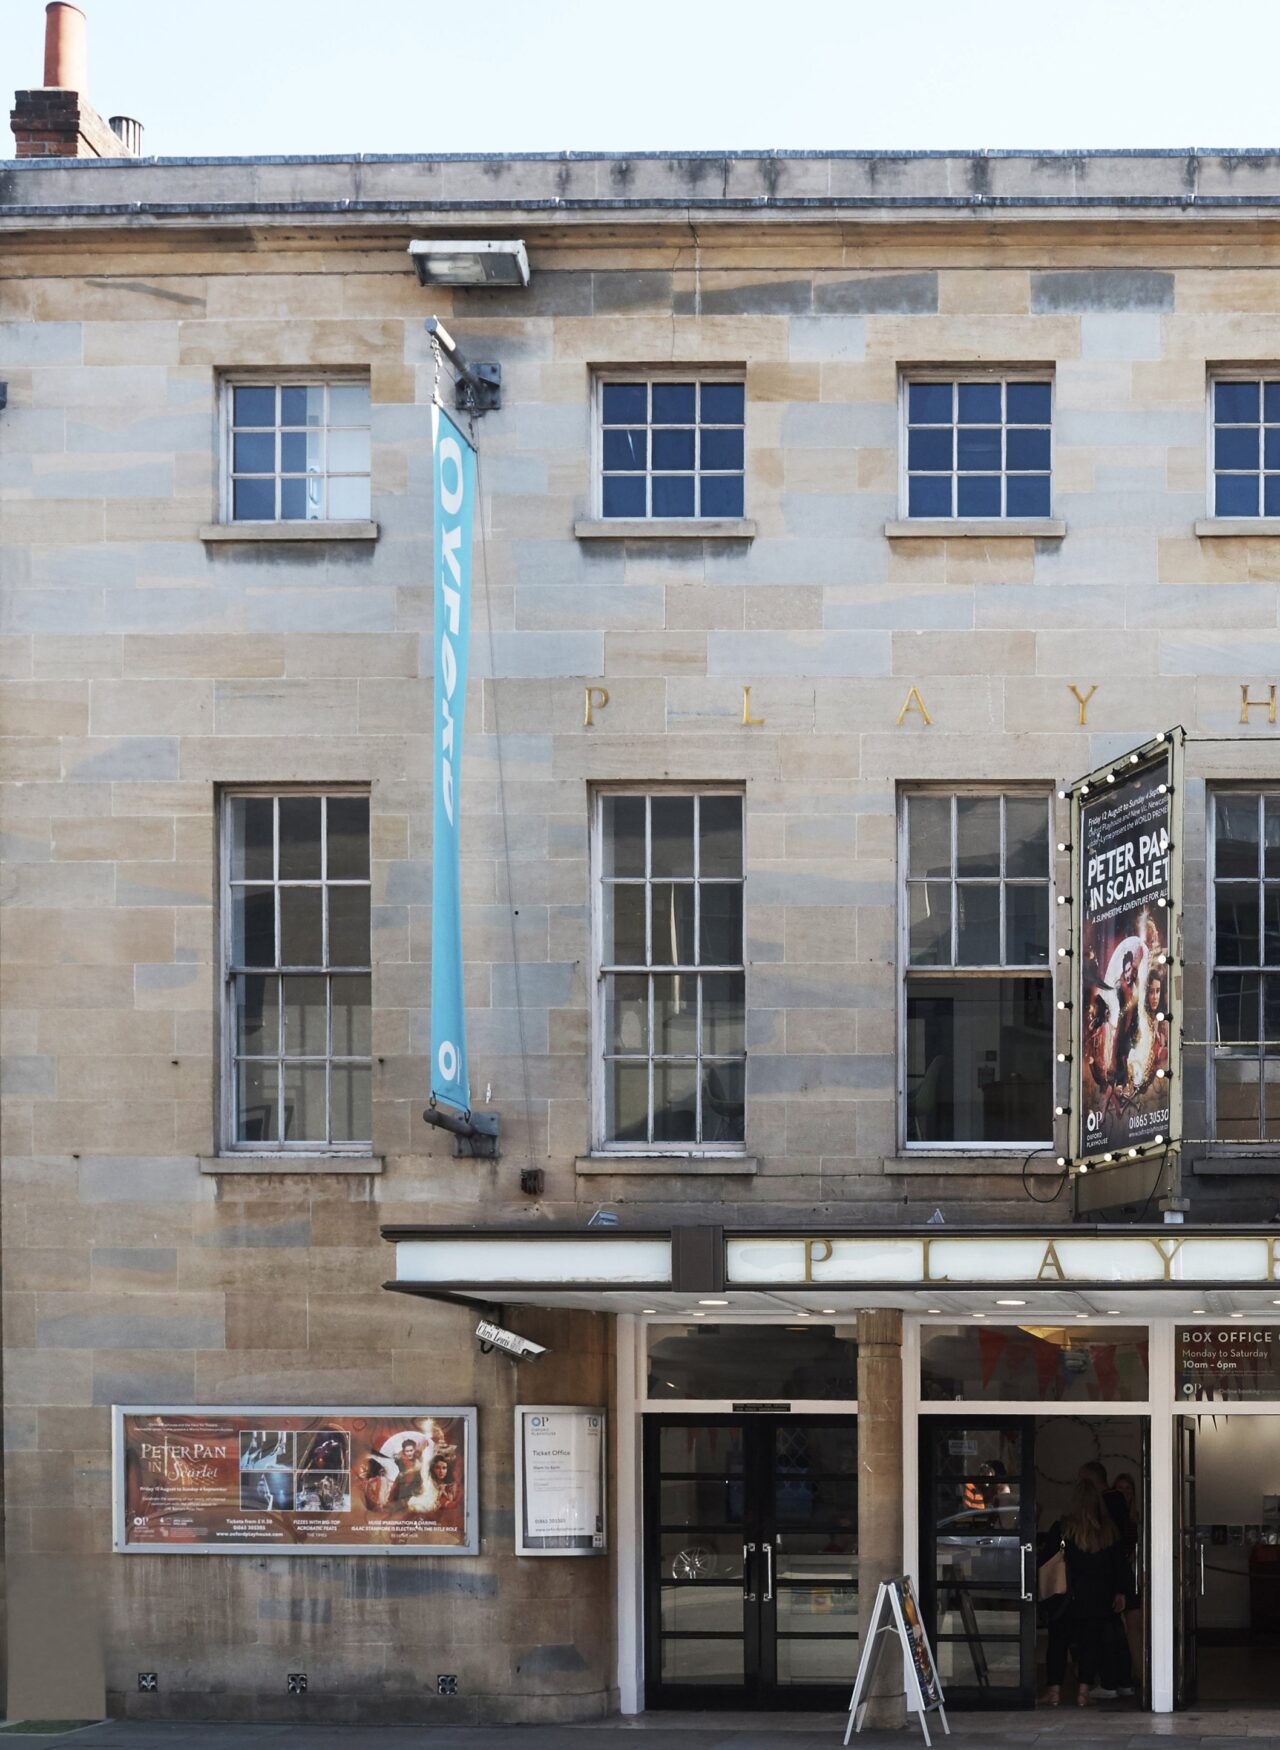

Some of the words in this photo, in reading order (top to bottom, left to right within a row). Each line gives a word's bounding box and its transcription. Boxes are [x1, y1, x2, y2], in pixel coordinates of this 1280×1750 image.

[1088, 816, 1100, 826] Friday
[1108, 804, 1122, 818] August
[1129, 796, 1145, 808] Sunday
[1102, 817, 1121, 831] Playhouse
[1122, 813, 1130, 822] and
[1131, 808, 1140, 818] New
[1112, 827, 1126, 838] present
[1135, 813, 1152, 826] WORLD
[1088, 842, 1136, 886] PETER
[1090, 884, 1104, 912] IN
[1106, 857, 1168, 904] SCARLET
[1096, 905, 1122, 923] SUMMERTIME
[1123, 895, 1148, 912] ADVENTURE
[1149, 891, 1159, 900] FOR
[1087, 1111, 1103, 1132] OP
[1129, 1113, 1148, 1129] 01865
[1149, 1109, 1168, 1125] 30530
[1087, 1132, 1102, 1140] OXFORD
[1087, 1138, 1108, 1148] PLAYHOUSE
[1183, 1332, 1212, 1342] BOX
[1218, 1332, 1272, 1342] OFFICE
[1182, 1349, 1216, 1360] Monday
[1220, 1350, 1228, 1358] to
[1230, 1348, 1268, 1358] Saturday
[1184, 1360, 1208, 1368] 10am
[1216, 1360, 1236, 1370] 6pm
[531, 1416, 549, 1427] OP
[141, 1439, 199, 1463] PETER
[194, 1444, 226, 1459] PAN
[148, 1462, 162, 1472] IN
[168, 1461, 218, 1481] Scarlet
